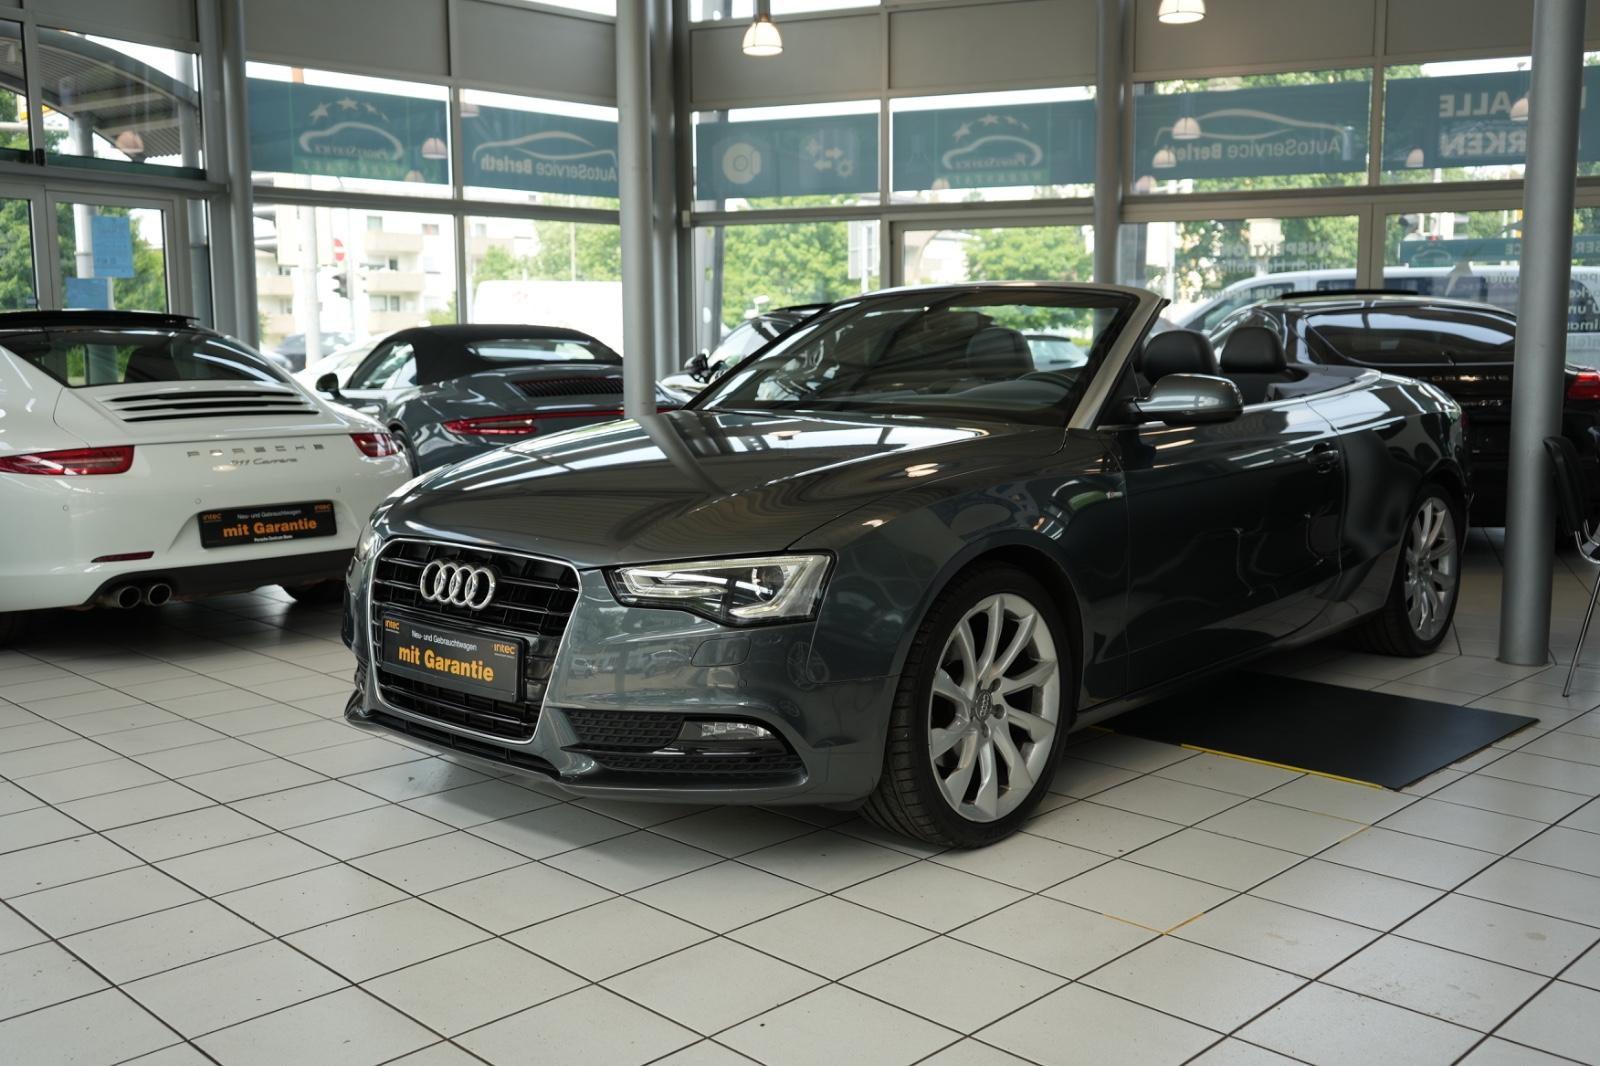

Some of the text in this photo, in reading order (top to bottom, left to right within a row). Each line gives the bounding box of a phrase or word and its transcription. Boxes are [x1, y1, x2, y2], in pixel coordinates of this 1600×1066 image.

[187, 444, 324, 457] PORSCHE
[223, 518, 317, 537] mit Garantie
[385, 619, 400, 630] intec
[411, 630, 423, 640] Neu-
[423, 634, 433, 643] und
[433, 635, 478, 652] Gebrauchtwagen
[494, 643, 516, 655] intec
[398, 645, 494, 682] mit Garantie
